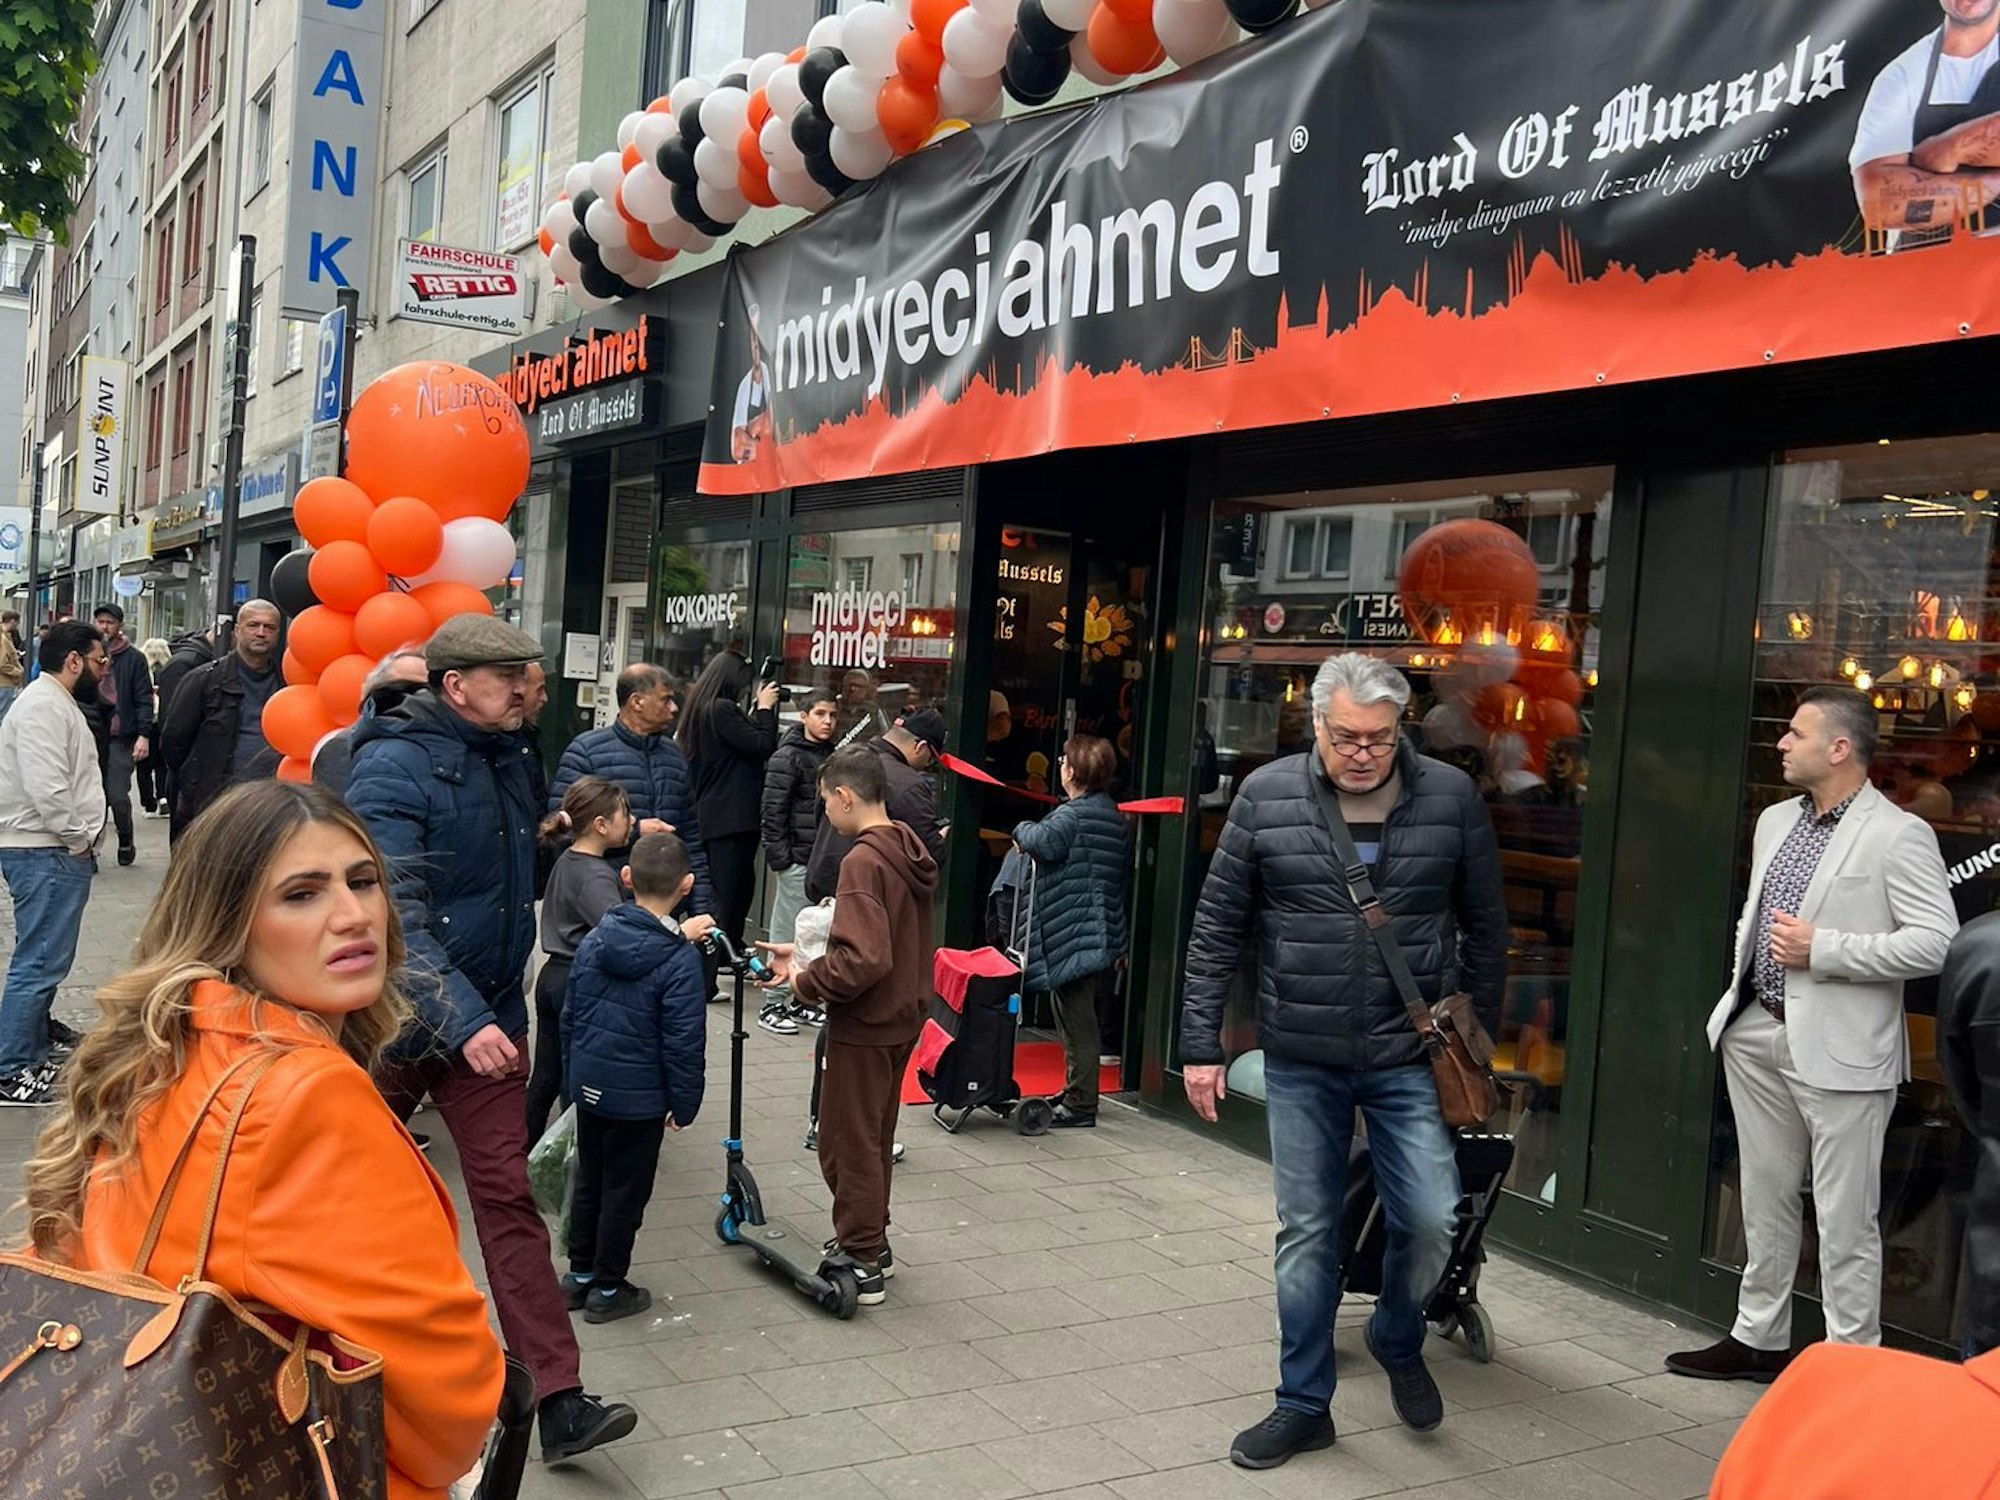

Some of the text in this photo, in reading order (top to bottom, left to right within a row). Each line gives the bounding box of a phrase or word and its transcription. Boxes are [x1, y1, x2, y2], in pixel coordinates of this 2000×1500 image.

[308, 0, 365, 287] ANK
[1361, 35, 1847, 215] Lord Of Mussels
[1561, 188, 1587, 209] en
[1590, 154, 1675, 202] lezzetli
[410, 243, 516, 271] FAHRSCHULE
[421, 275, 511, 293] RETTIG
[404, 302, 517, 329] fahrschule-rettig.de
[573, 312, 649, 388] ahmet
[540, 387, 637, 437] Lord Of Mussels
[666, 592, 738, 630] KOKOREÇ
[811, 578, 908, 635] midyeci
